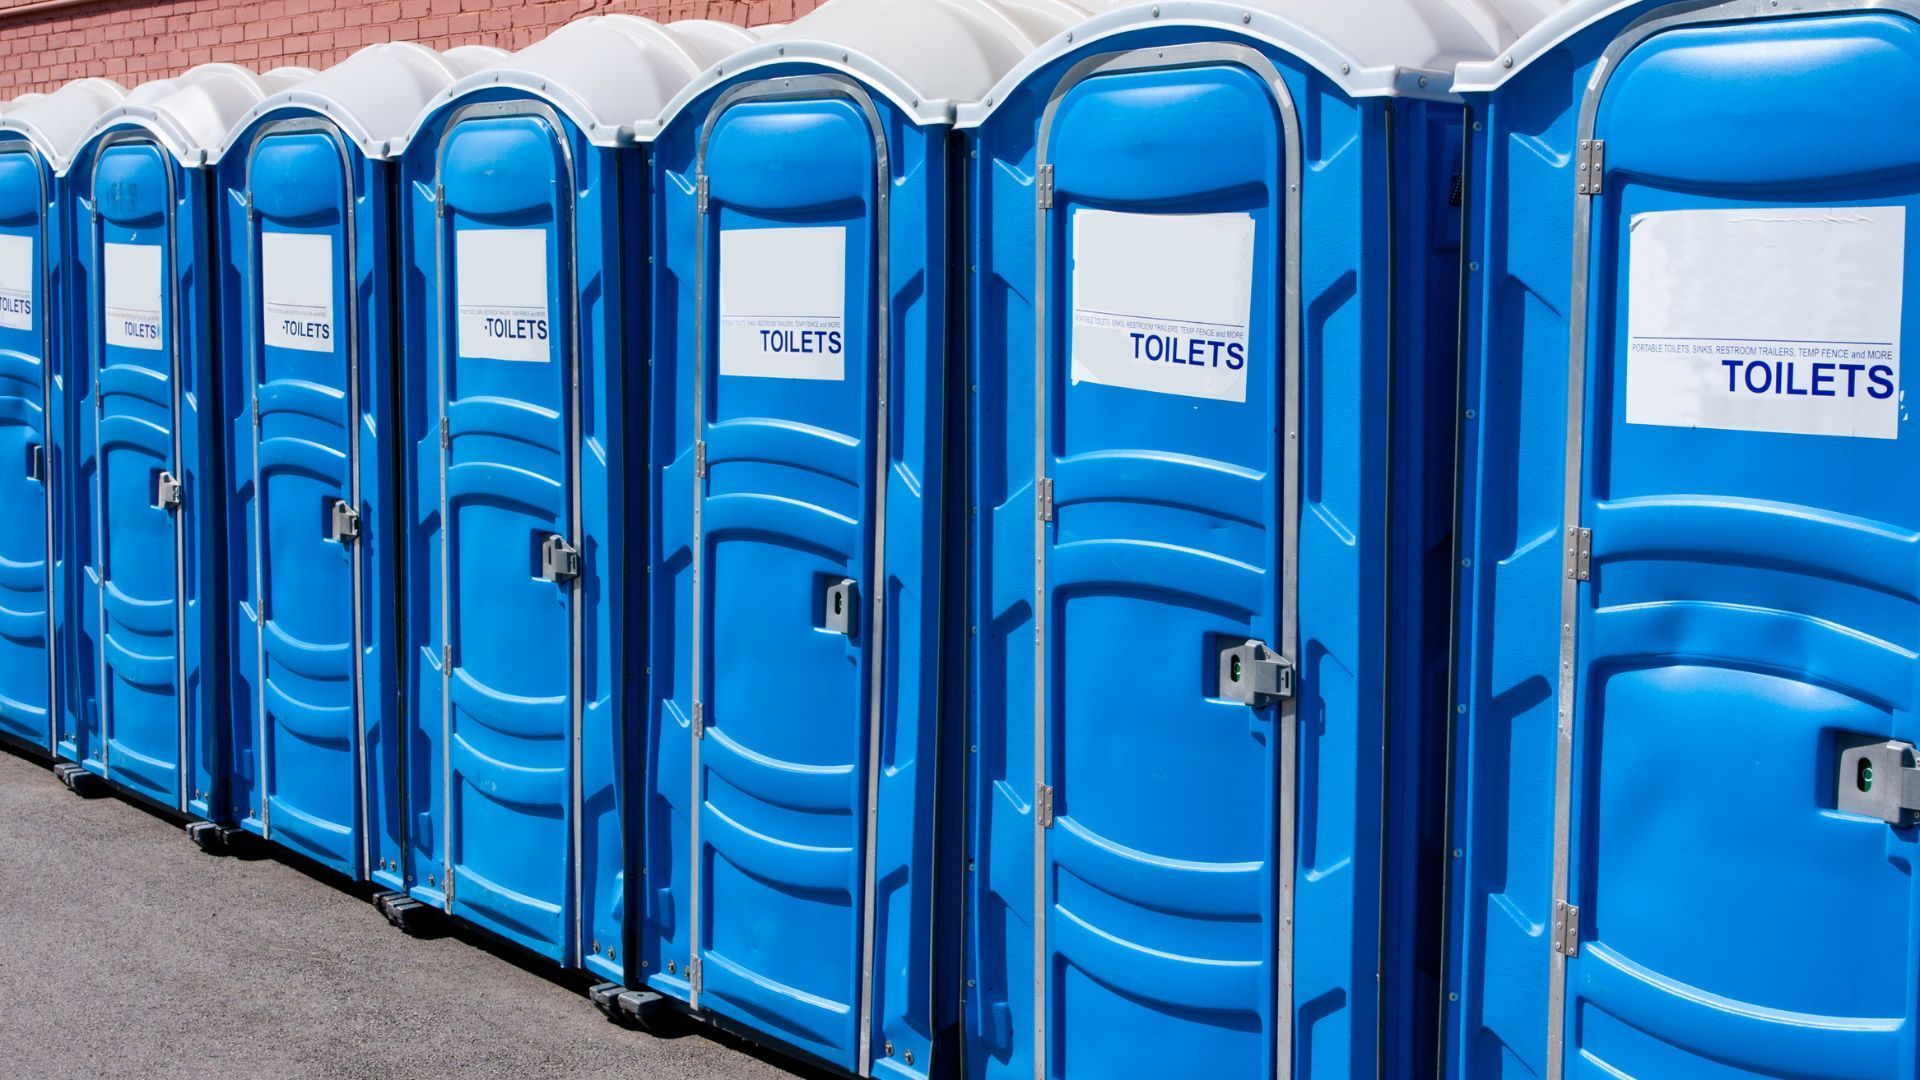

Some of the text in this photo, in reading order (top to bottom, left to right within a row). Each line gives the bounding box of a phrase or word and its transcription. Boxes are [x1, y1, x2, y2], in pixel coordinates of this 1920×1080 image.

[760, 329, 842, 354] TOILETS
[1180, 326, 1196, 335] TEMP
[1196, 327, 1215, 337] FENCE
[1226, 330, 1244, 340] MORE
[1129, 332, 1245, 370] TOILETS
[1632, 343, 1662, 353] PORTABLE
[1716, 345, 1757, 356] RESTROOM
[1758, 346, 1796, 358] TRAILERS,
[1799, 347, 1820, 358] TEMP
[1821, 348, 1849, 359] FENCE
[1851, 350, 1866, 359] and
[1867, 350, 1893, 360] MORE
[1721, 359, 1895, 400] TOILETS
